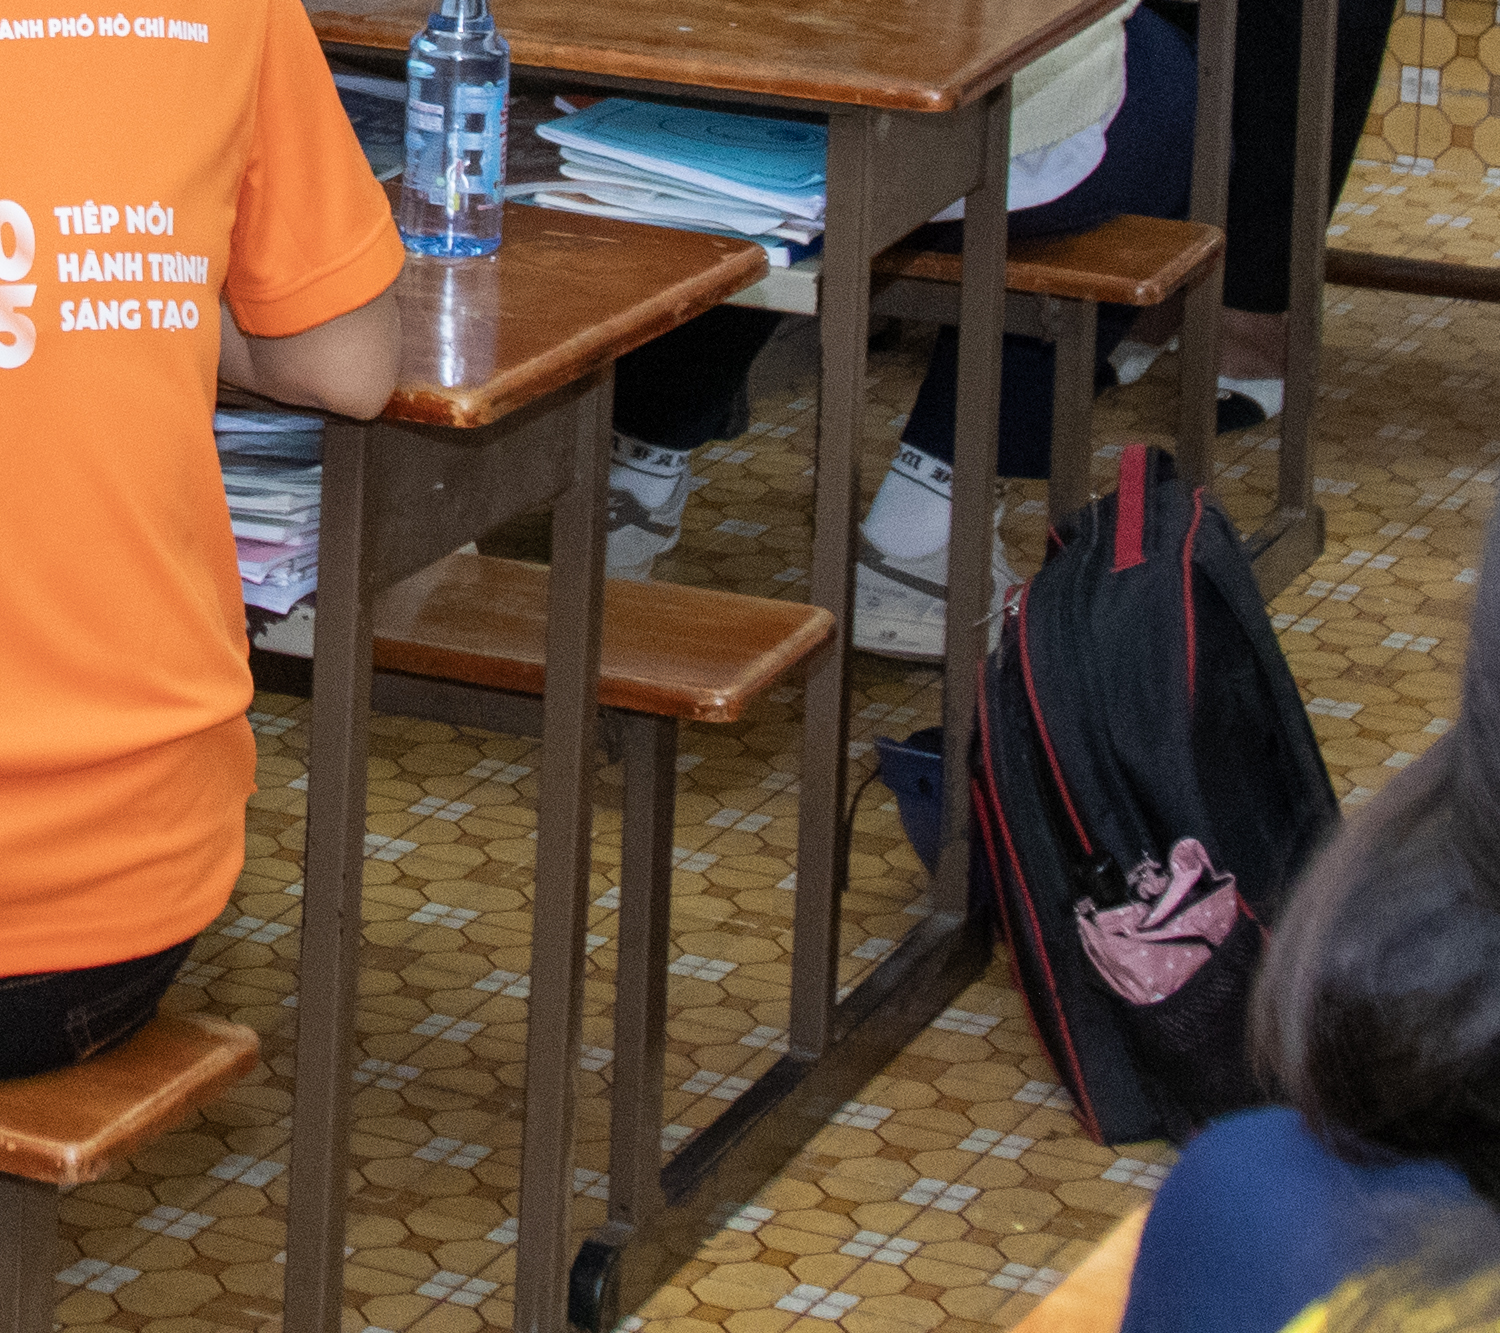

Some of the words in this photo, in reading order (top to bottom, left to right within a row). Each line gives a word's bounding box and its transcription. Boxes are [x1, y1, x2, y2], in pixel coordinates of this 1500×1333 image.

[168, 19, 209, 44] MINH
[57, 249, 144, 283] HÀNH
[147, 251, 209, 285] TRÌNH
[60, 297, 142, 332] SÁNG
[147, 299, 200, 332] TẠO
